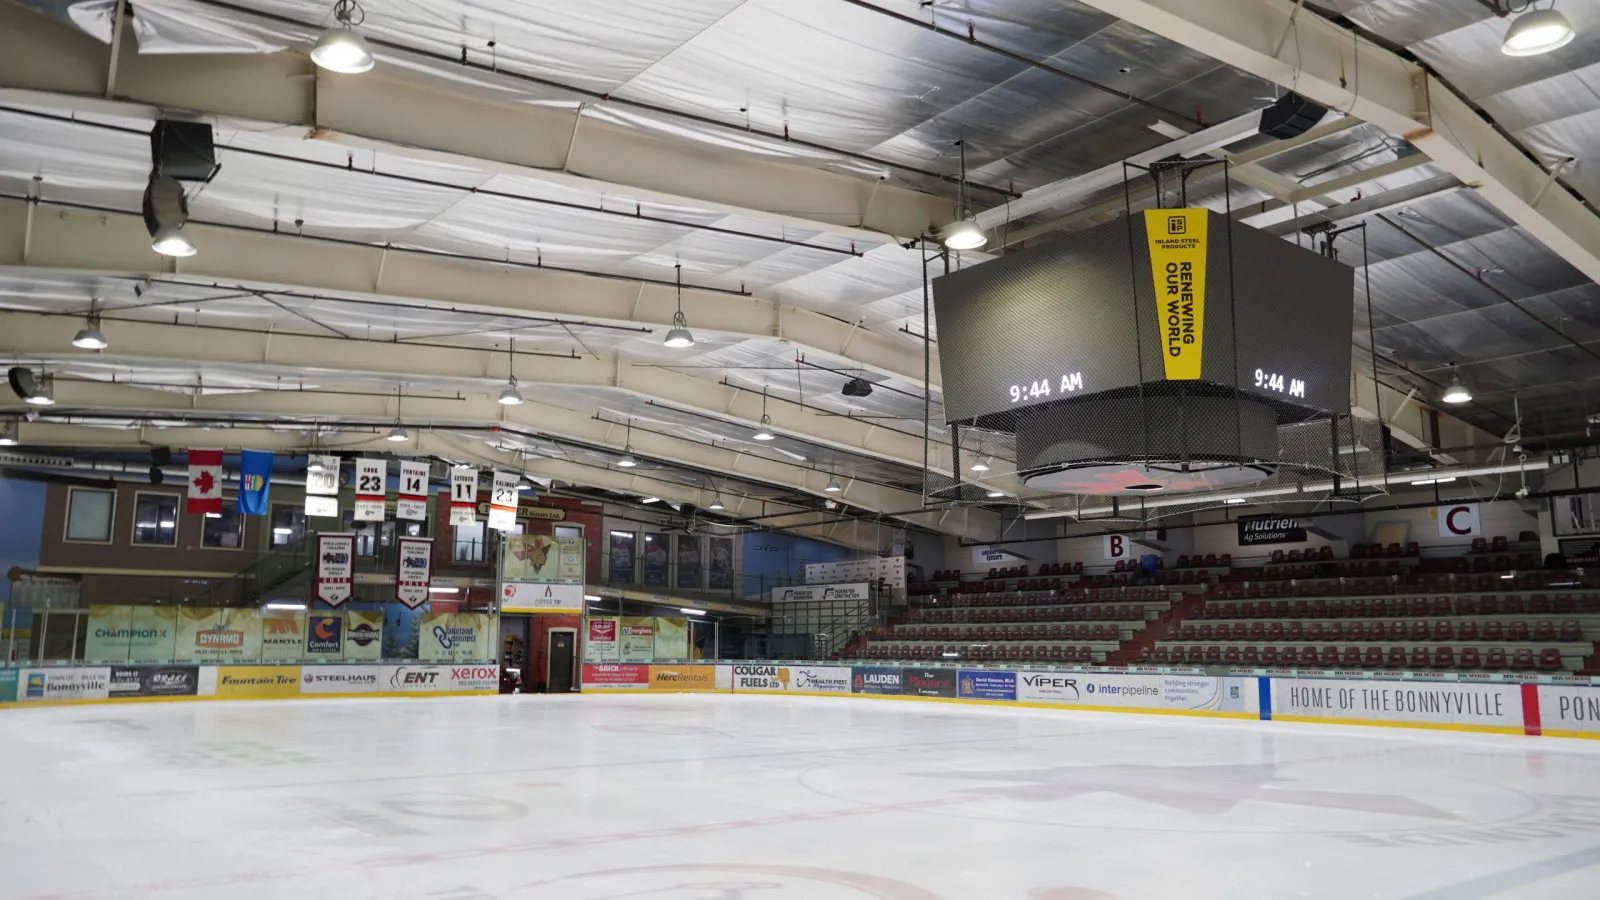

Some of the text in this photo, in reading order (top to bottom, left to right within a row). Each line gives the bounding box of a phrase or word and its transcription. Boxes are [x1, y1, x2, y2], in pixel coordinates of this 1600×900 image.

[1180, 262, 1195, 345] RENEWING
[1166, 263, 1181, 357] OUR WORLD
[1010, 372, 1083, 403] 9:44 AM
[1255, 368, 1304, 398] 9:44 AM
[360, 476, 381, 491] 23
[406, 478, 421, 492] 14
[456, 484, 471, 500] 11
[496, 489, 513, 503] 23
[1446, 506, 1472, 535] C
[1244, 532, 1286, 542] Ag Solutions
[1110, 536, 1123, 557] B
[200, 634, 240, 644] DYNAMO
[310, 641, 339, 649] Comfort
[451, 635, 476, 643] connect
[451, 668, 497, 680] xerox
[734, 666, 777, 676] COUGAR
[153, 674, 188, 683] DRAKE
[222, 676, 297, 685] Fountain Tire
[404, 672, 440, 684] ENT
[656, 673, 708, 682] HercRentals
[740, 678, 768, 688] FUELS
[864, 674, 899, 685] LAUDEN
[908, 676, 950, 688] Players
[1023, 675, 1079, 692] VIPER
[46, 681, 105, 694] Bonnyville
[1122, 686, 1159, 697] pipeline
[1291, 687, 1504, 716] HOME OF THE BONNYVILLE
